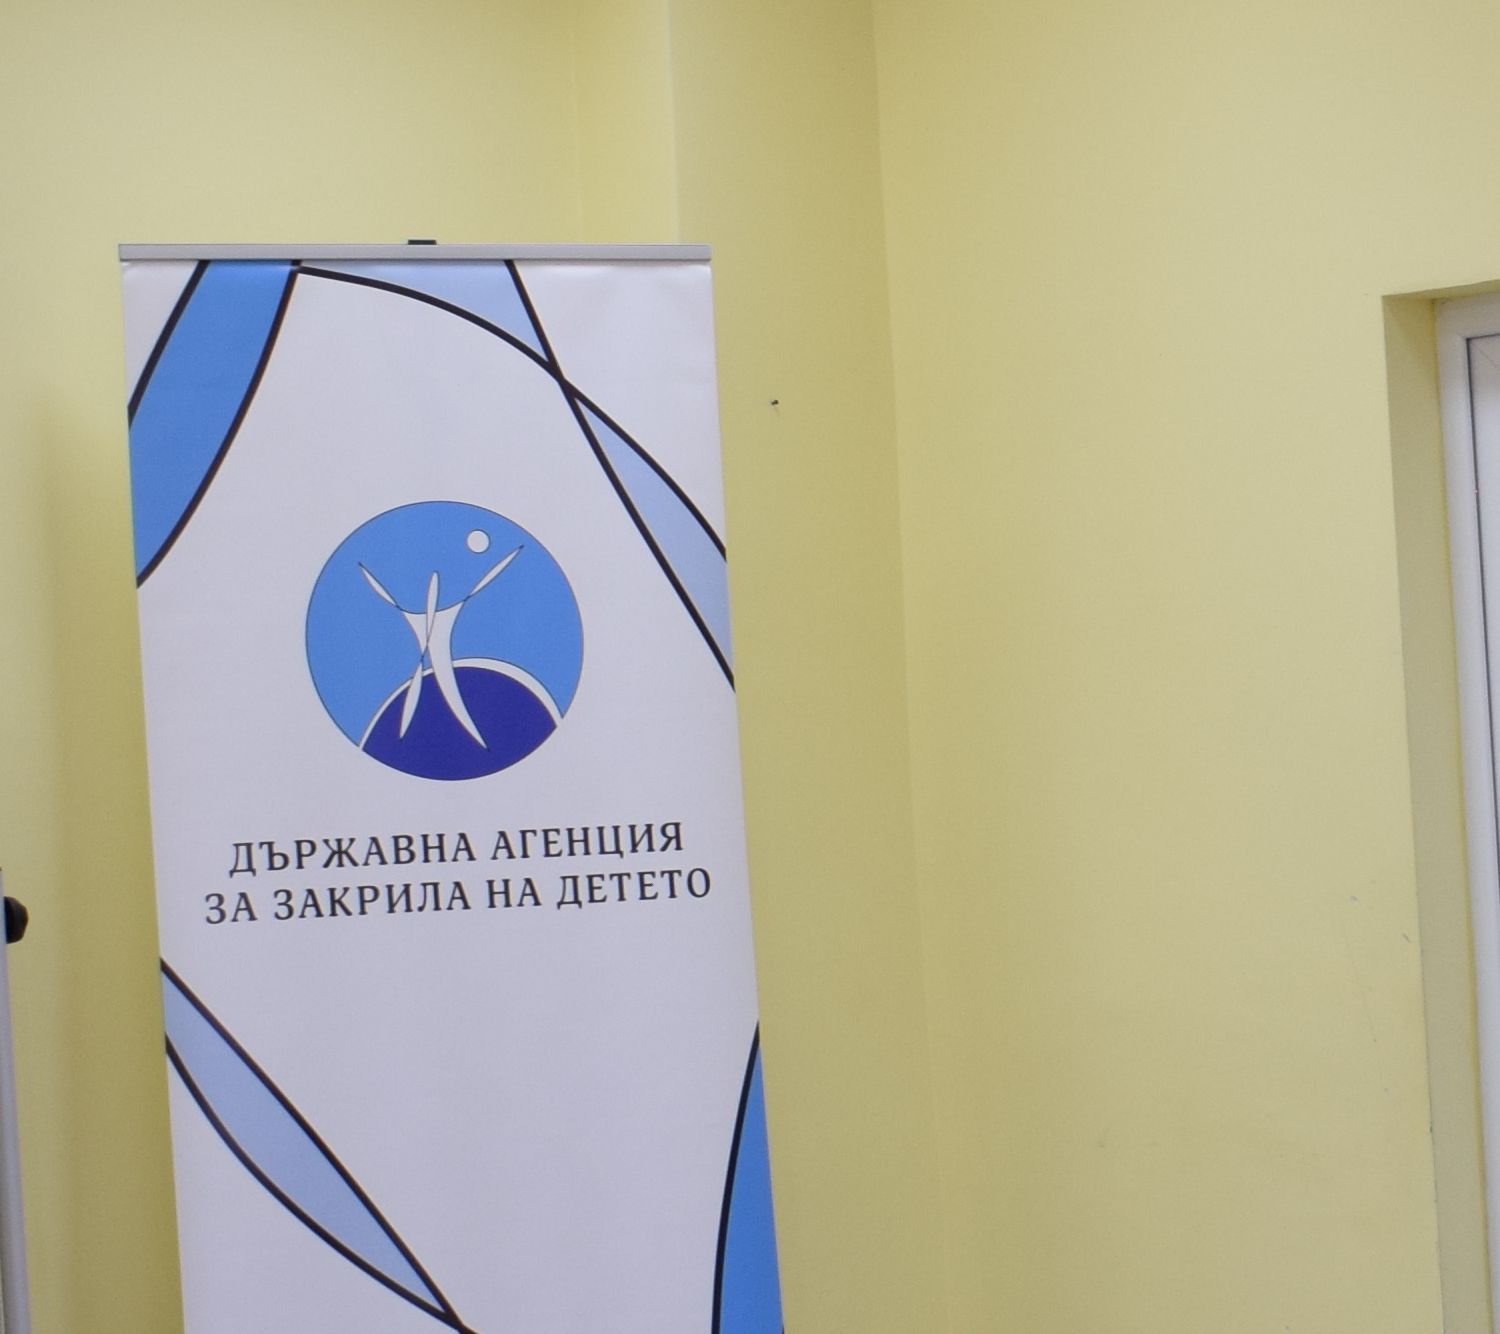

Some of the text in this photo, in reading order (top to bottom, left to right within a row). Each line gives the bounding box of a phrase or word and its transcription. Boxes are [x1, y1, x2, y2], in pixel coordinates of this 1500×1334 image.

[228, 821, 683, 879] ДЪРЖАВНА АГЕНЦИЯ
[205, 867, 711, 925] ЗА ЗАКРИЛА НА ДЕТЕТО
